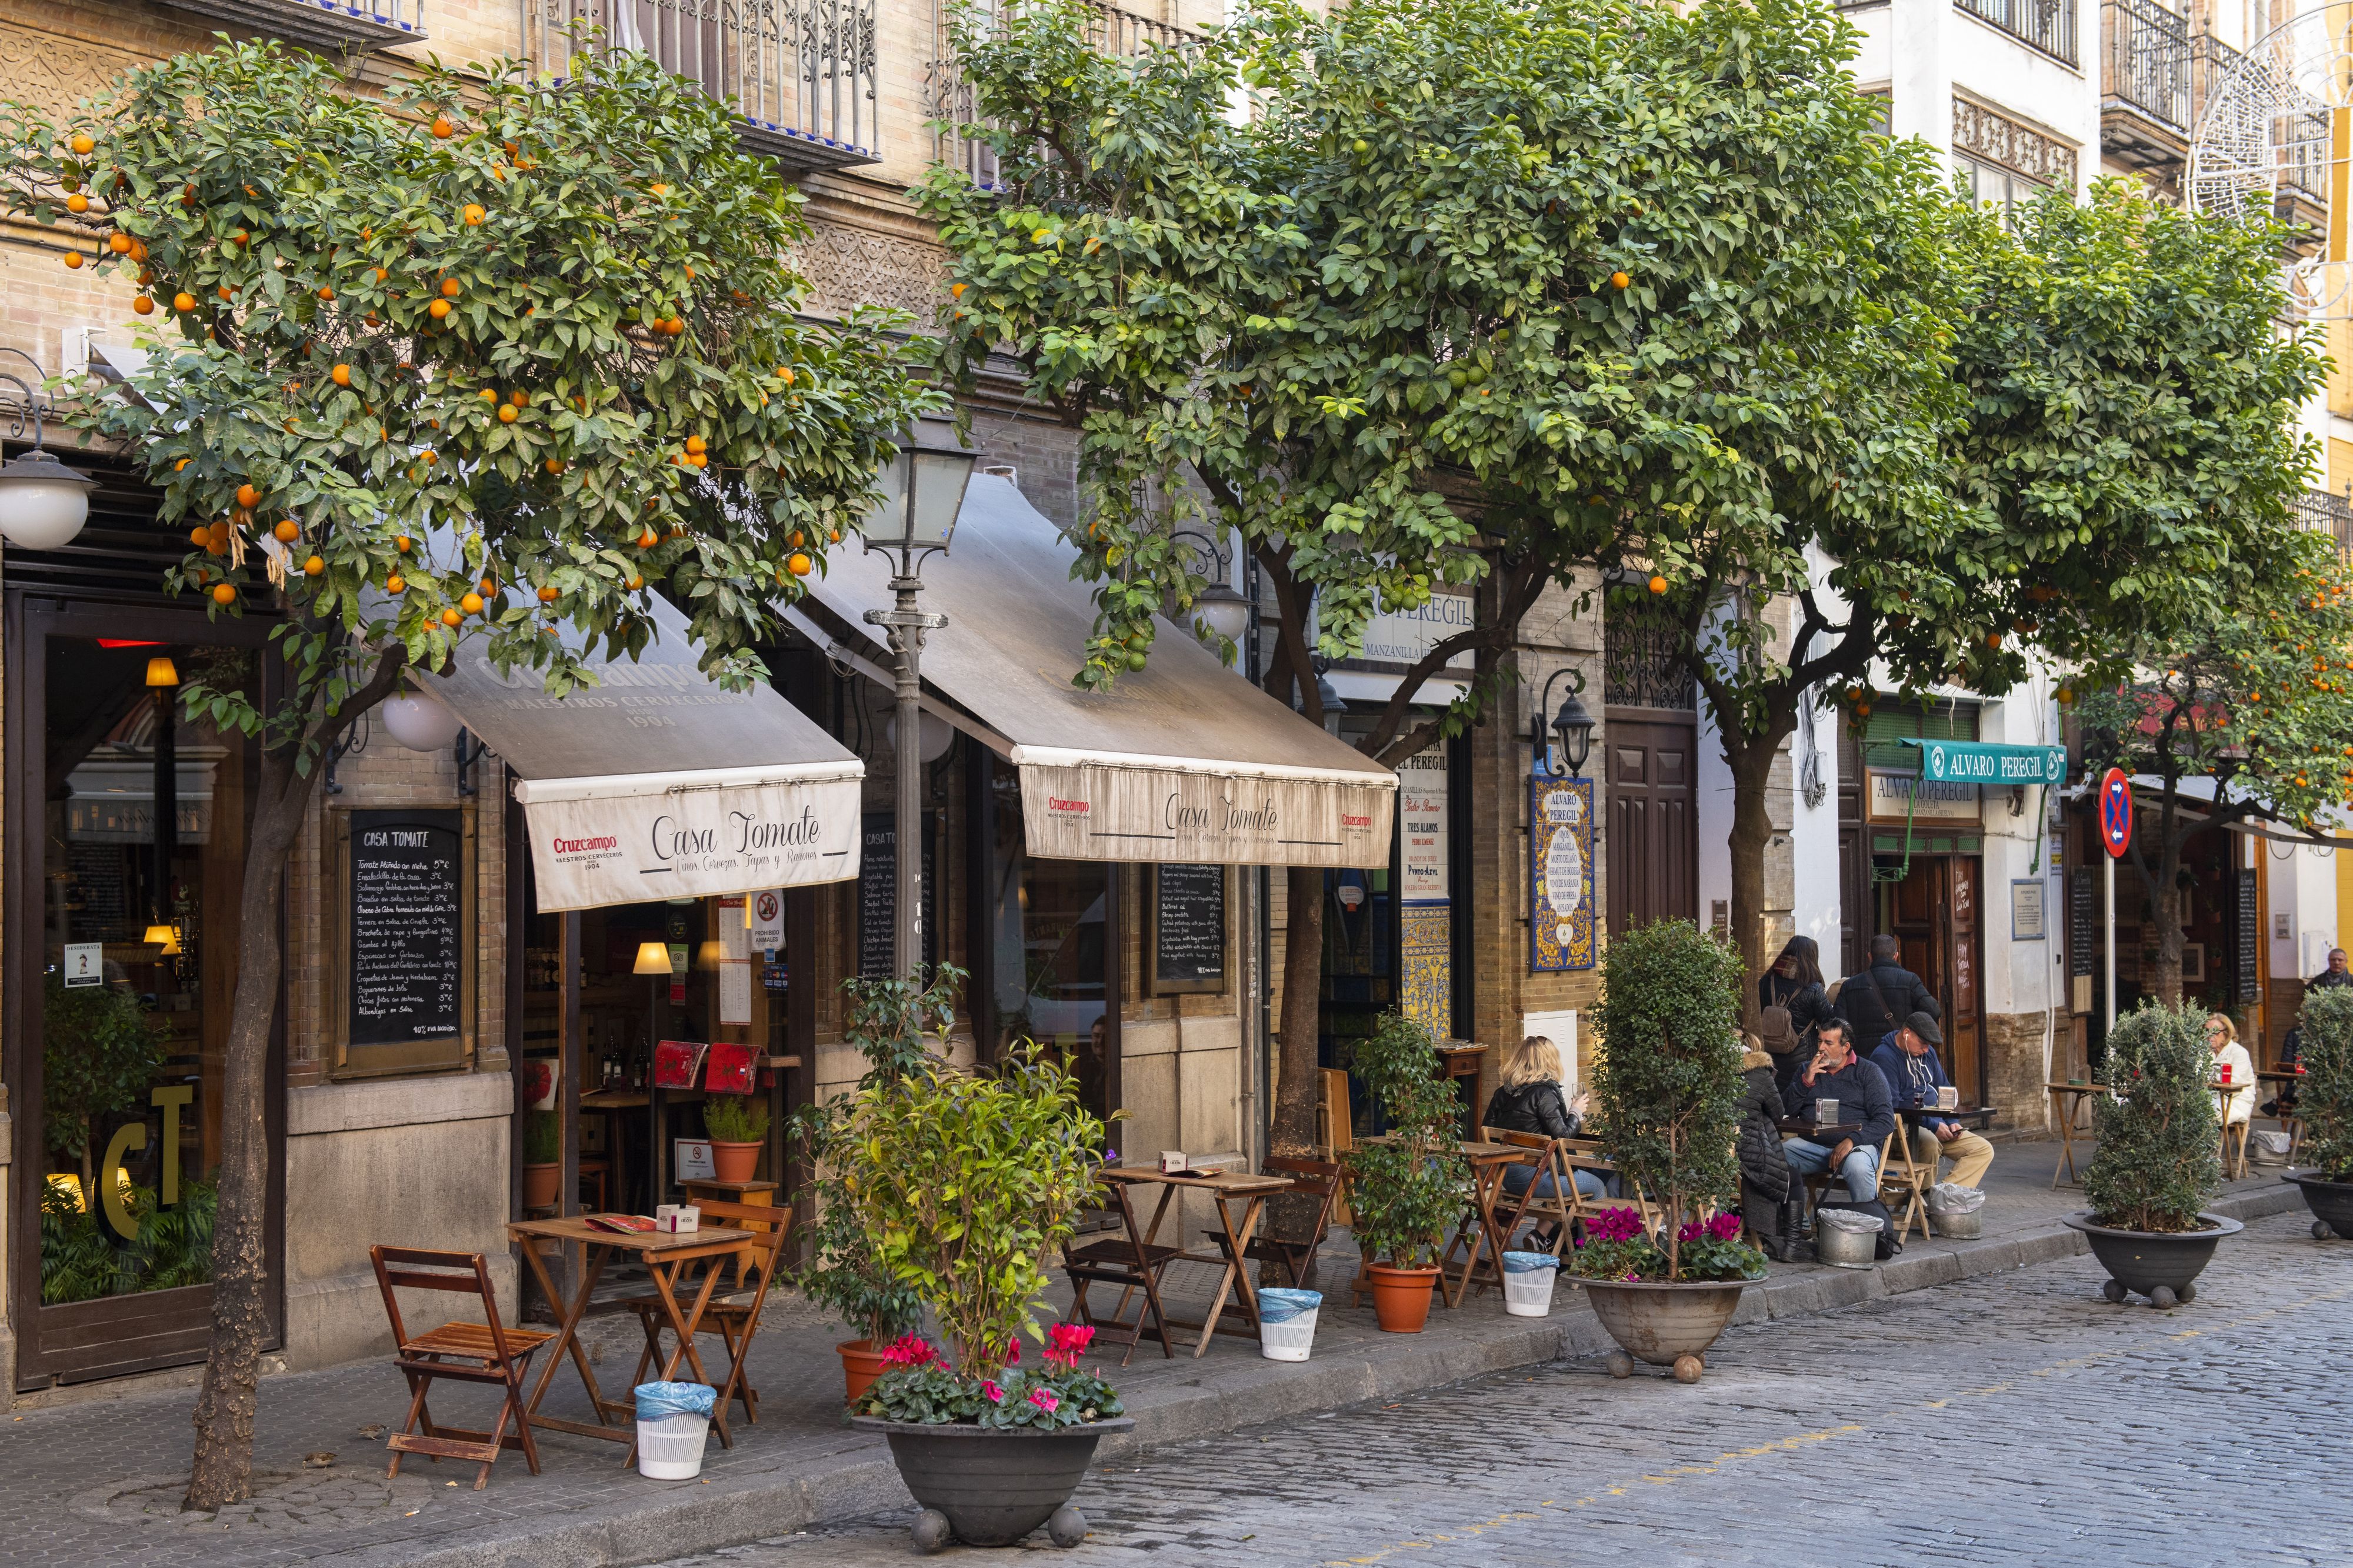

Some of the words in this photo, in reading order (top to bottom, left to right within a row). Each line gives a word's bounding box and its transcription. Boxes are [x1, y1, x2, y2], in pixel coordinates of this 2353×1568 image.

[1395, 597, 1471, 626] REGIL
[1367, 643, 1419, 659] MANZANILLA
[504, 697, 618, 710] MAESTROS
[621, 695, 745, 707] CERVECEROS
[626, 716, 677, 728] 1904
[1412, 756, 1447, 770] PEREGIL
[1950, 755, 1994, 776] ALVARO
[2001, 756, 2042, 777] PEREGIL
[1929, 780, 1972, 801] PEREGIL
[1049, 796, 1089, 814] Cruzcampo
[1405, 799, 1420, 812] Pedro
[1422, 799, 1441, 812] Romero
[1551, 795, 1577, 805] ALVARO
[1914, 800, 1920, 808] LA
[1921, 800, 1939, 809] GOLETA
[1166, 793, 1211, 830] Casa
[1219, 796, 1278, 830] Tomate
[1550, 810, 1577, 820] PEREGIL
[1342, 813, 1371, 828] Cruzcampo
[652, 816, 718, 860] Casa
[729, 805, 821, 853] Tomate
[1407, 823, 1419, 833] TRES
[1421, 823, 1438, 833] ALAMOS
[364, 832, 388, 846] CASA
[391, 832, 429, 848] TOMATE
[866, 833, 885, 845] CASA
[1559, 830, 1569, 839] VINOS
[554, 836, 616, 853] Cruzcampo
[1553, 842, 1575, 851] MANZANILLA
[588, 852, 622, 860] CERVECEROS
[742, 853, 769, 872] Tapas
[774, 856, 780, 869] y
[786, 848, 817, 864] Raciones
[1551, 855, 1562, 863] MOSTO
[358, 860, 379, 869] Tomate
[380, 861, 401, 869] Aliñado
[357, 871, 391, 880] Ensaladilla
[1567, 867, 1581, 875] BODEGA
[1549, 879, 1559, 888] VINO
[357, 894, 379, 902] Bacalao
[1552, 892, 1561, 900] VINO
[1567, 892, 1577, 900] FRESA
[358, 905, 374, 913] Queso
[1557, 903, 1573, 912] ANISADOS
[357, 917, 376, 925] Ternera
[357, 928, 382, 936] Brocheta
[407, 930, 411, 938] y
[357, 940, 379, 948] Gambas
[391, 940, 406, 949] Ajillo
[358, 951, 386, 963] Espinacas
[1958, 943, 1967, 961] HAY
[357, 973, 381, 985] Croquetas
[404, 975, 408, 983] y
[358, 995, 374, 1005] Chocos
[376, 995, 389, 1007] fritos
[359, 1006, 386, 1019] Albondigas
[413, 1025, 426, 1035] 10%
